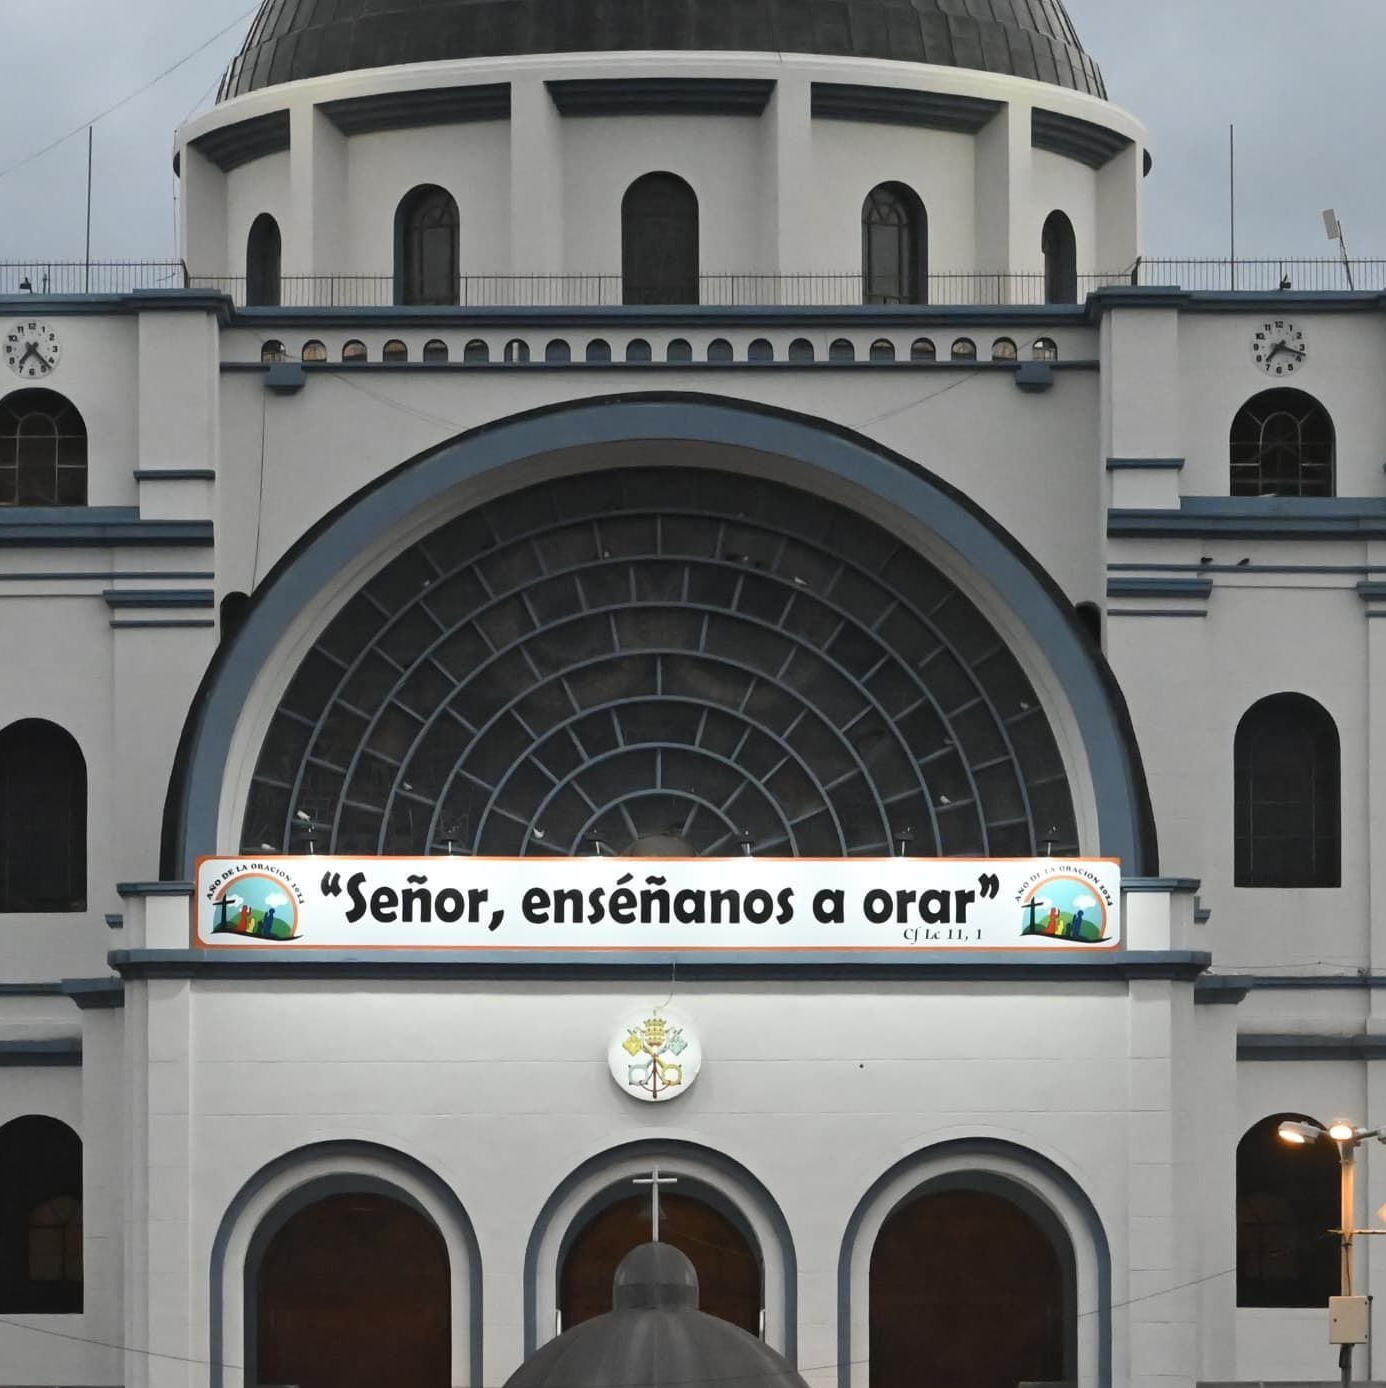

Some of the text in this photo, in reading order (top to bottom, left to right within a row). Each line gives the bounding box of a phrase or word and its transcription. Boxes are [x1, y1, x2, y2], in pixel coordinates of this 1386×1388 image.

[221, 869, 234, 880] DE
[236, 864, 248, 873] LA
[320, 871, 1000, 932] “Señor, enséñanos a orar”
